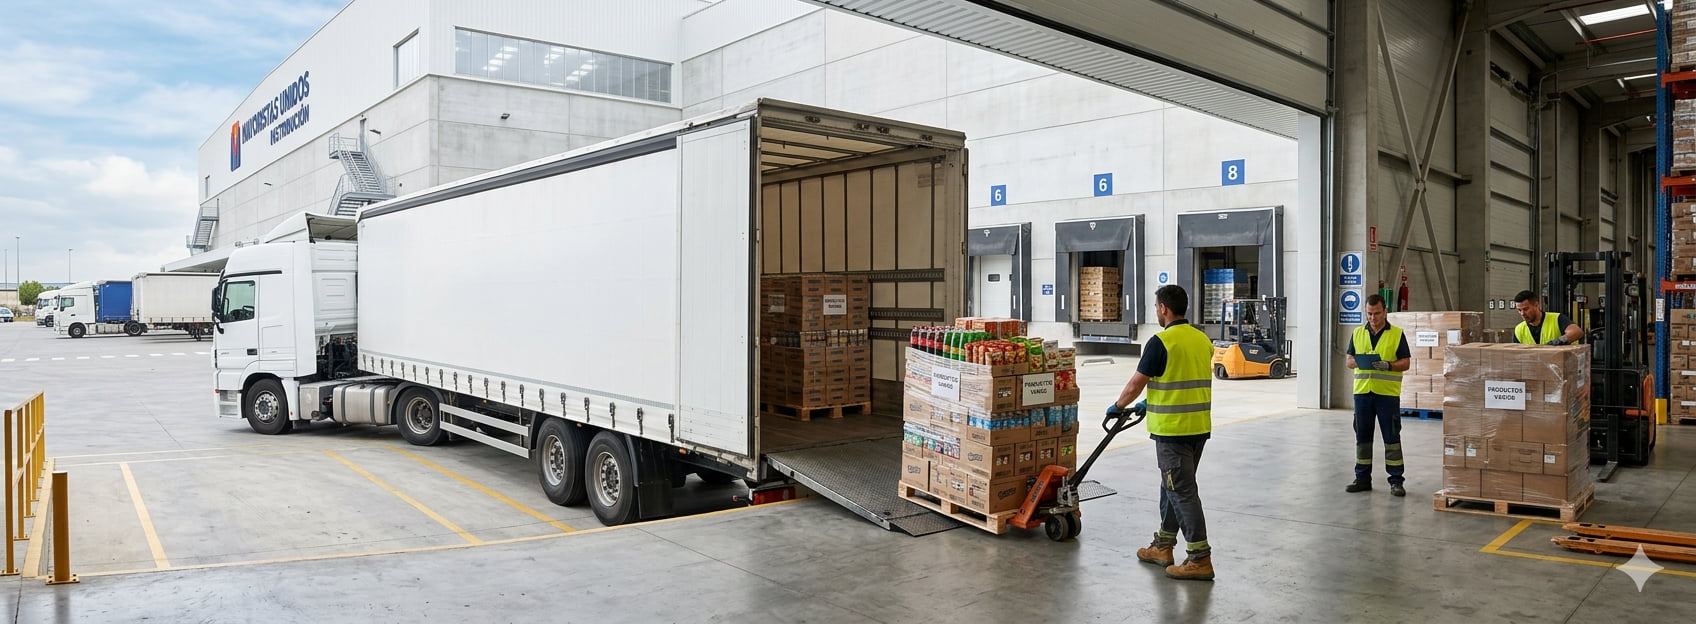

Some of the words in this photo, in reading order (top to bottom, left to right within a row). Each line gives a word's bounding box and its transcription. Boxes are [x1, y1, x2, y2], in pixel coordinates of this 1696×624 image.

[279, 71, 309, 116] UNIDOS
[1227, 165, 1238, 180] 8
[1098, 178, 1107, 192] 6
[994, 189, 1002, 202] 6
